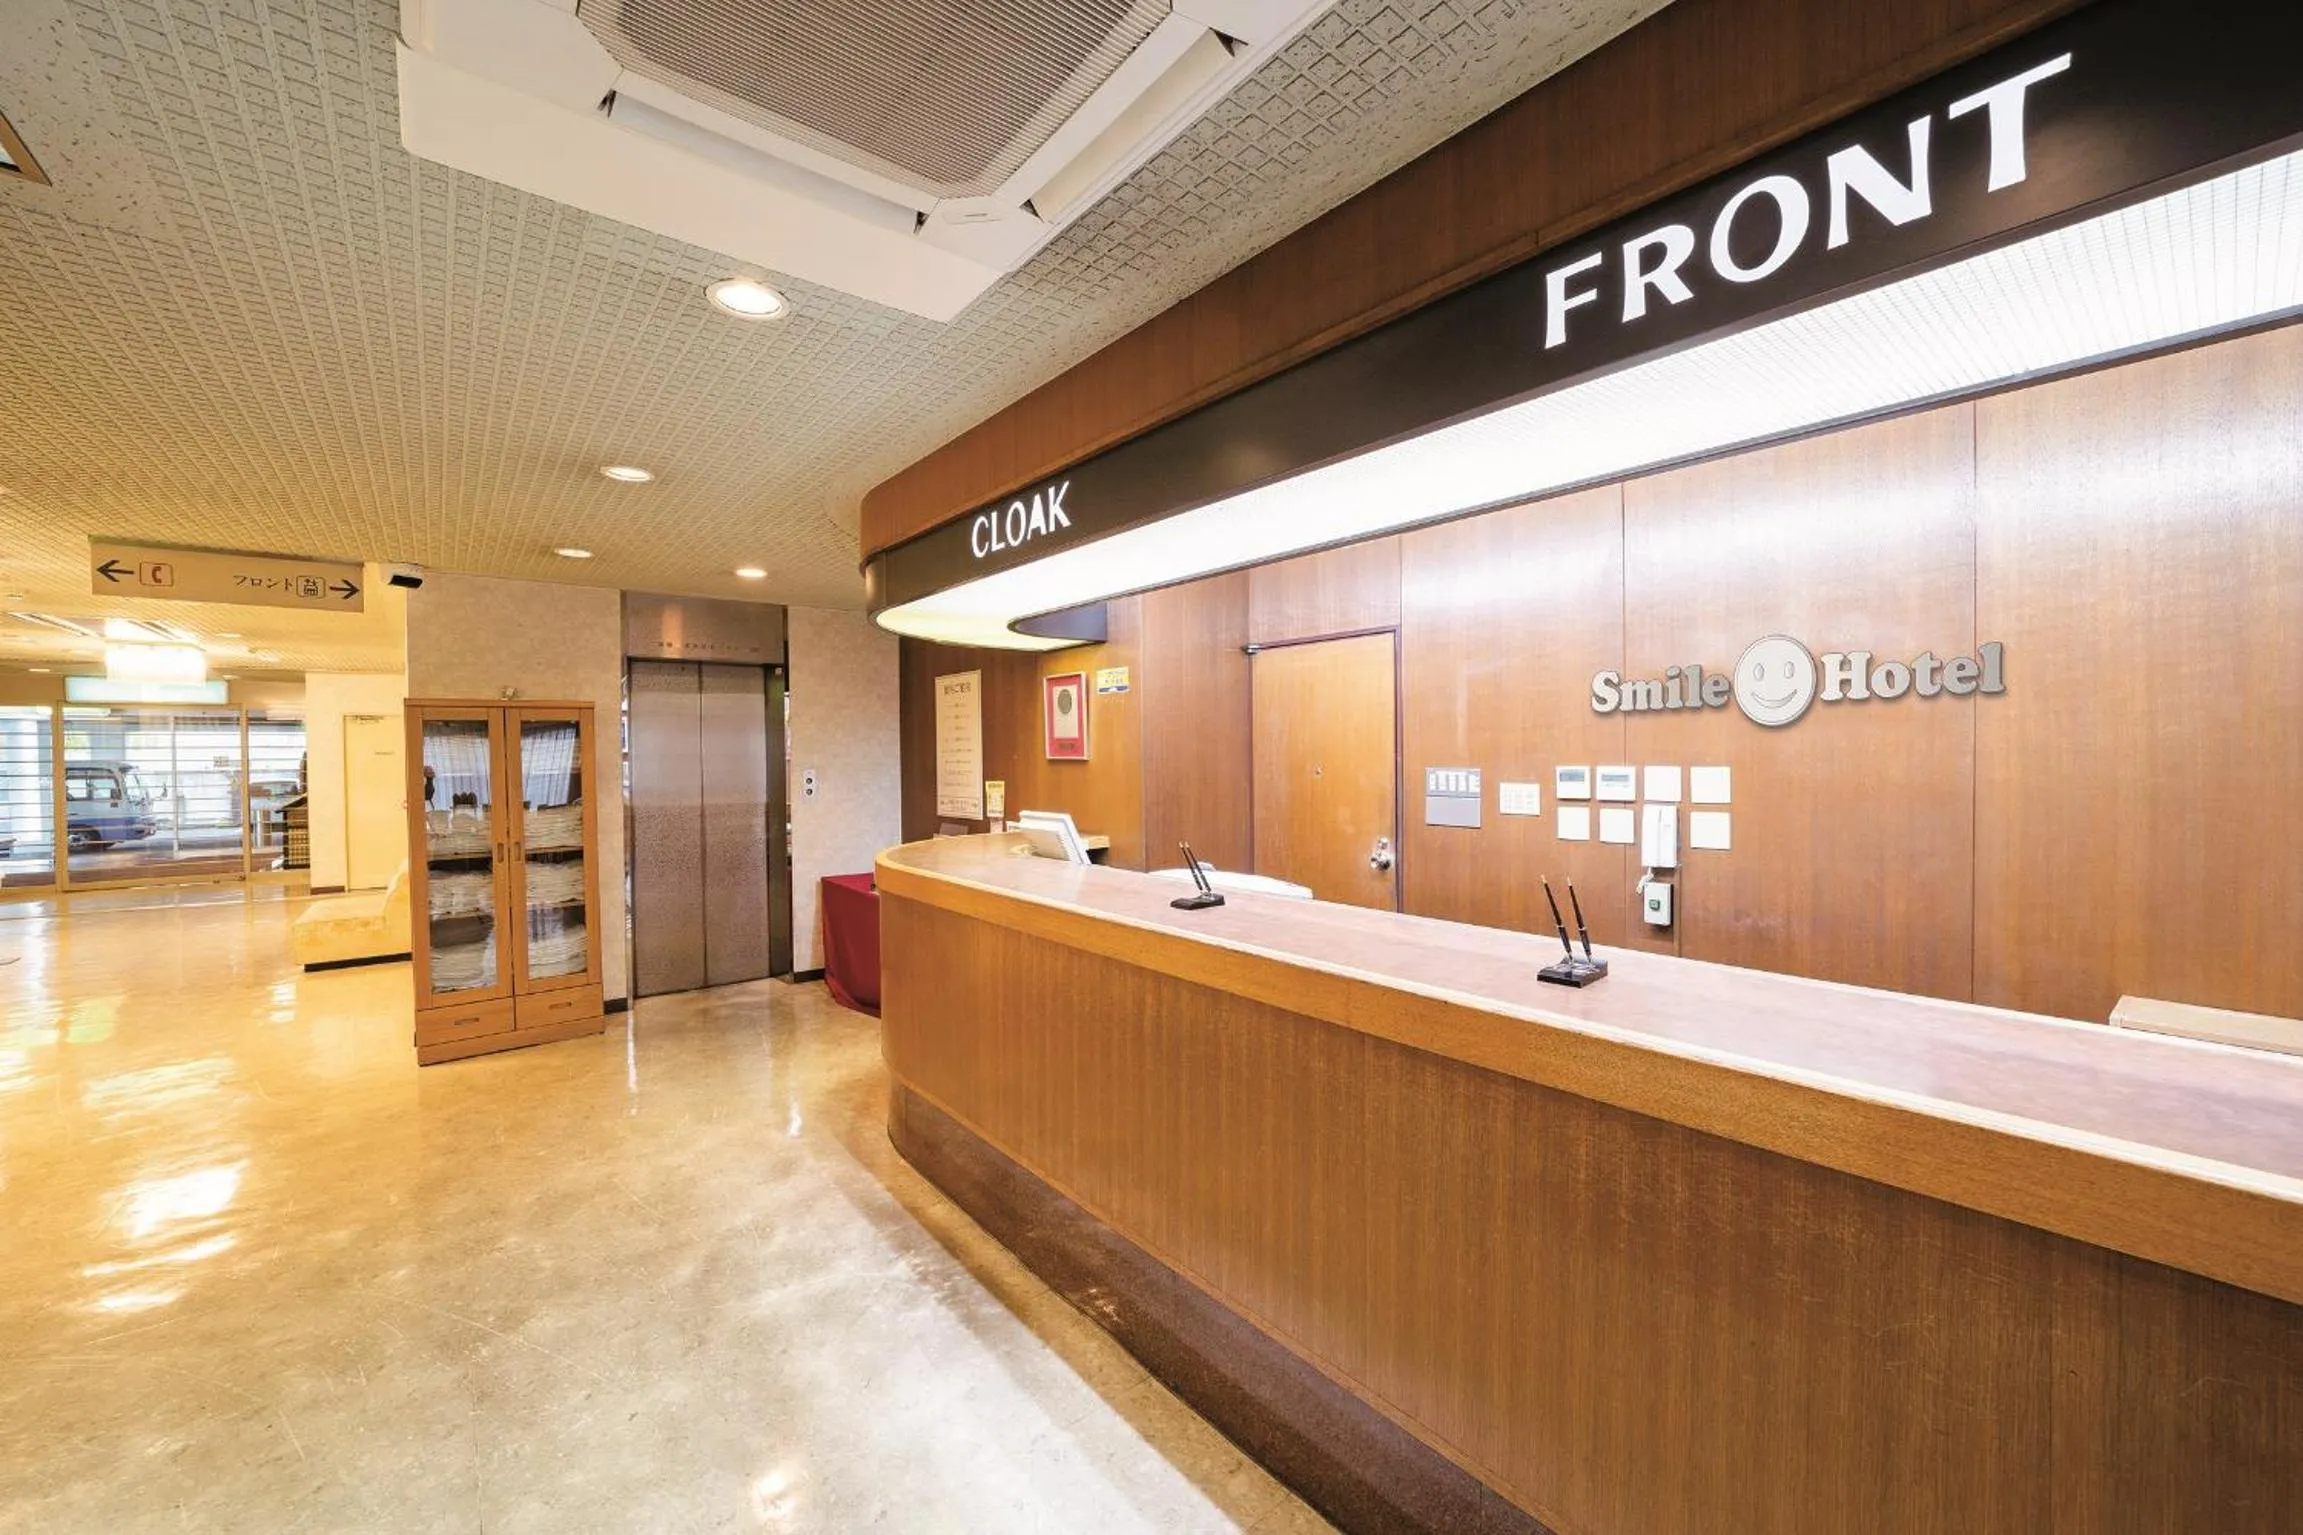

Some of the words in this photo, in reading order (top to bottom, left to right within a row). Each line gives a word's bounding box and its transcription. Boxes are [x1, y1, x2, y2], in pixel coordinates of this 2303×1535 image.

[1544, 52, 2072, 349] FRONT
[971, 480, 1072, 558] CLOAK
[233, 575, 292, 591] フロント
[1591, 665, 1731, 713] Smile
[1820, 642, 2006, 701] Hotel
